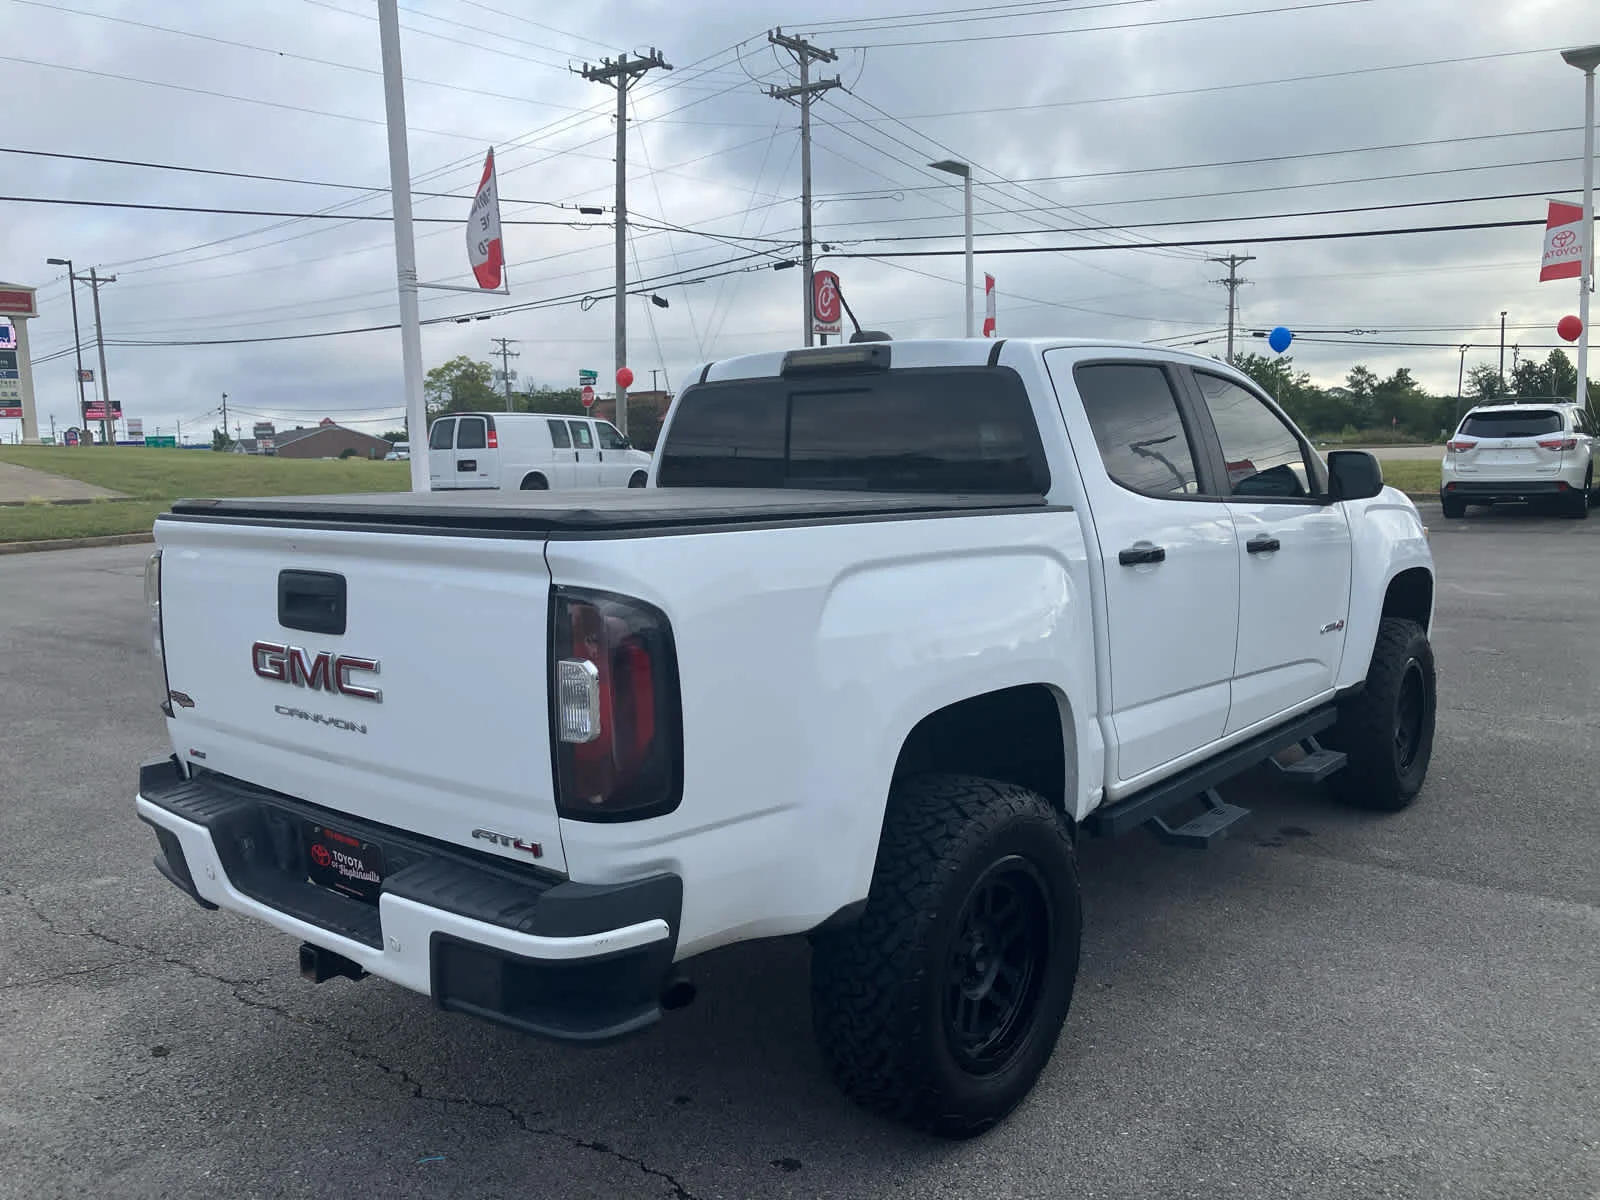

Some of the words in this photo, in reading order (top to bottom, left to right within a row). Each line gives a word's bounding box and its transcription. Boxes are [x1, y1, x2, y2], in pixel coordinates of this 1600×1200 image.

[252, 640, 383, 704] GMC
[274, 704, 367, 734] CANYON
[472, 828, 543, 858] AT4
[332, 850, 364, 871] TOYOTA
